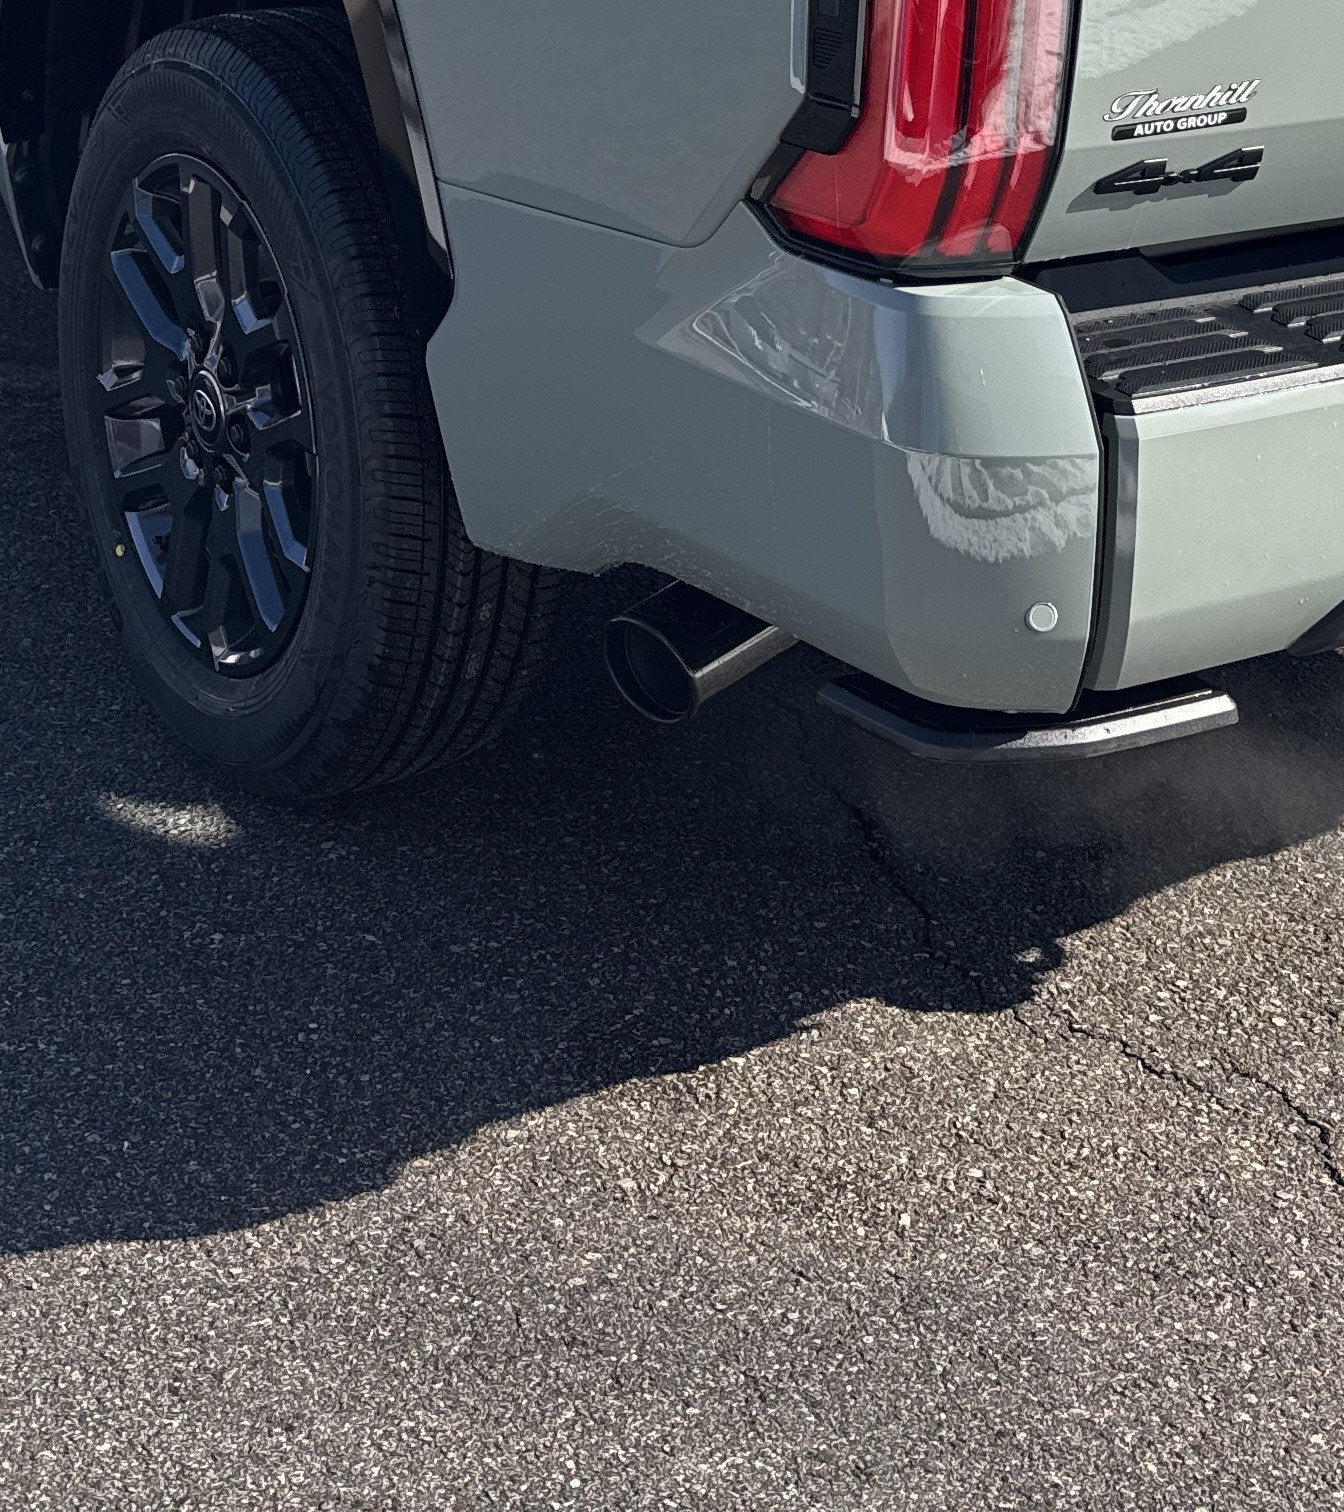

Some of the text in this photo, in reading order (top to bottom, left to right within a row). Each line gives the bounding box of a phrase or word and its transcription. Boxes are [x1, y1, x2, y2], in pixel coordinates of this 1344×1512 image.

[1102, 78, 1262, 123] Thornhill
[1133, 112, 1228, 137] AUTO GROUP
